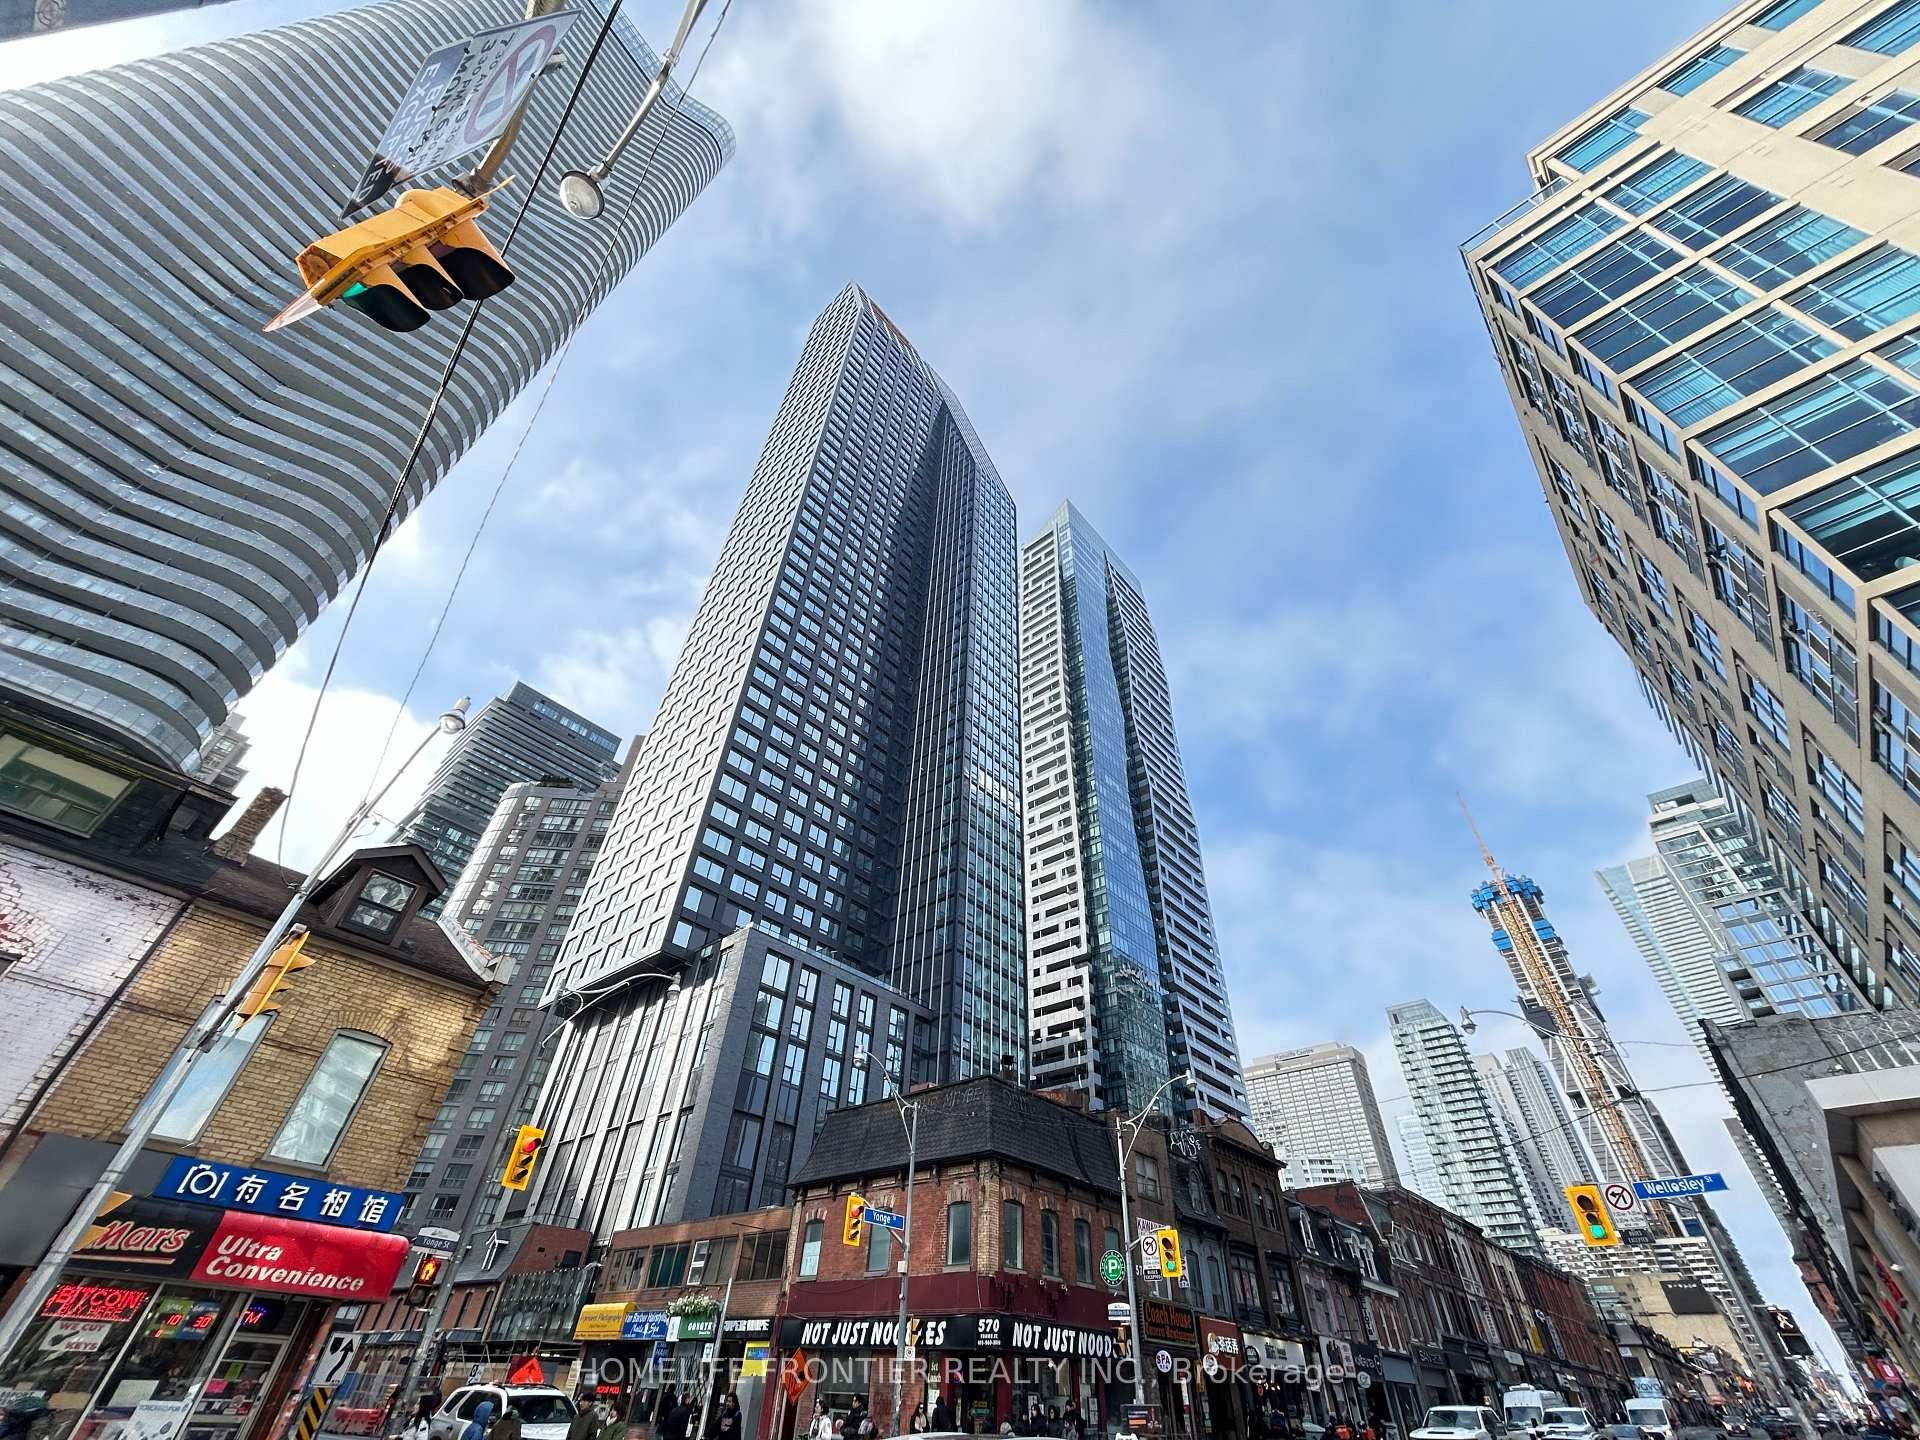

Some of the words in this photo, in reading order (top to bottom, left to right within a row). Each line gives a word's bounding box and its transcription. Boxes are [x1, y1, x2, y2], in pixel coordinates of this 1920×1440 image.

[352, 61, 442, 205] EXCEPTED
[383, 84, 444, 175] BUSES
[235, 1174, 388, 1225] 有名相馆
[872, 1210, 890, 1225] Yonge
[216, 1235, 284, 1262] Ultra
[205, 1256, 365, 1293] Convenience
[1108, 1260, 1118, 1274] P
[165, 1315, 182, 1326] 10
[192, 1316, 212, 1329] 30
[801, 1322, 832, 1345] NOT
[831, 1321, 869, 1345] JUST
[978, 1318, 1000, 1332] 570
[1012, 1322, 1042, 1350] NOT
[1043, 1327, 1076, 1353] JUST
[1157, 1355, 1170, 1365] SPA
